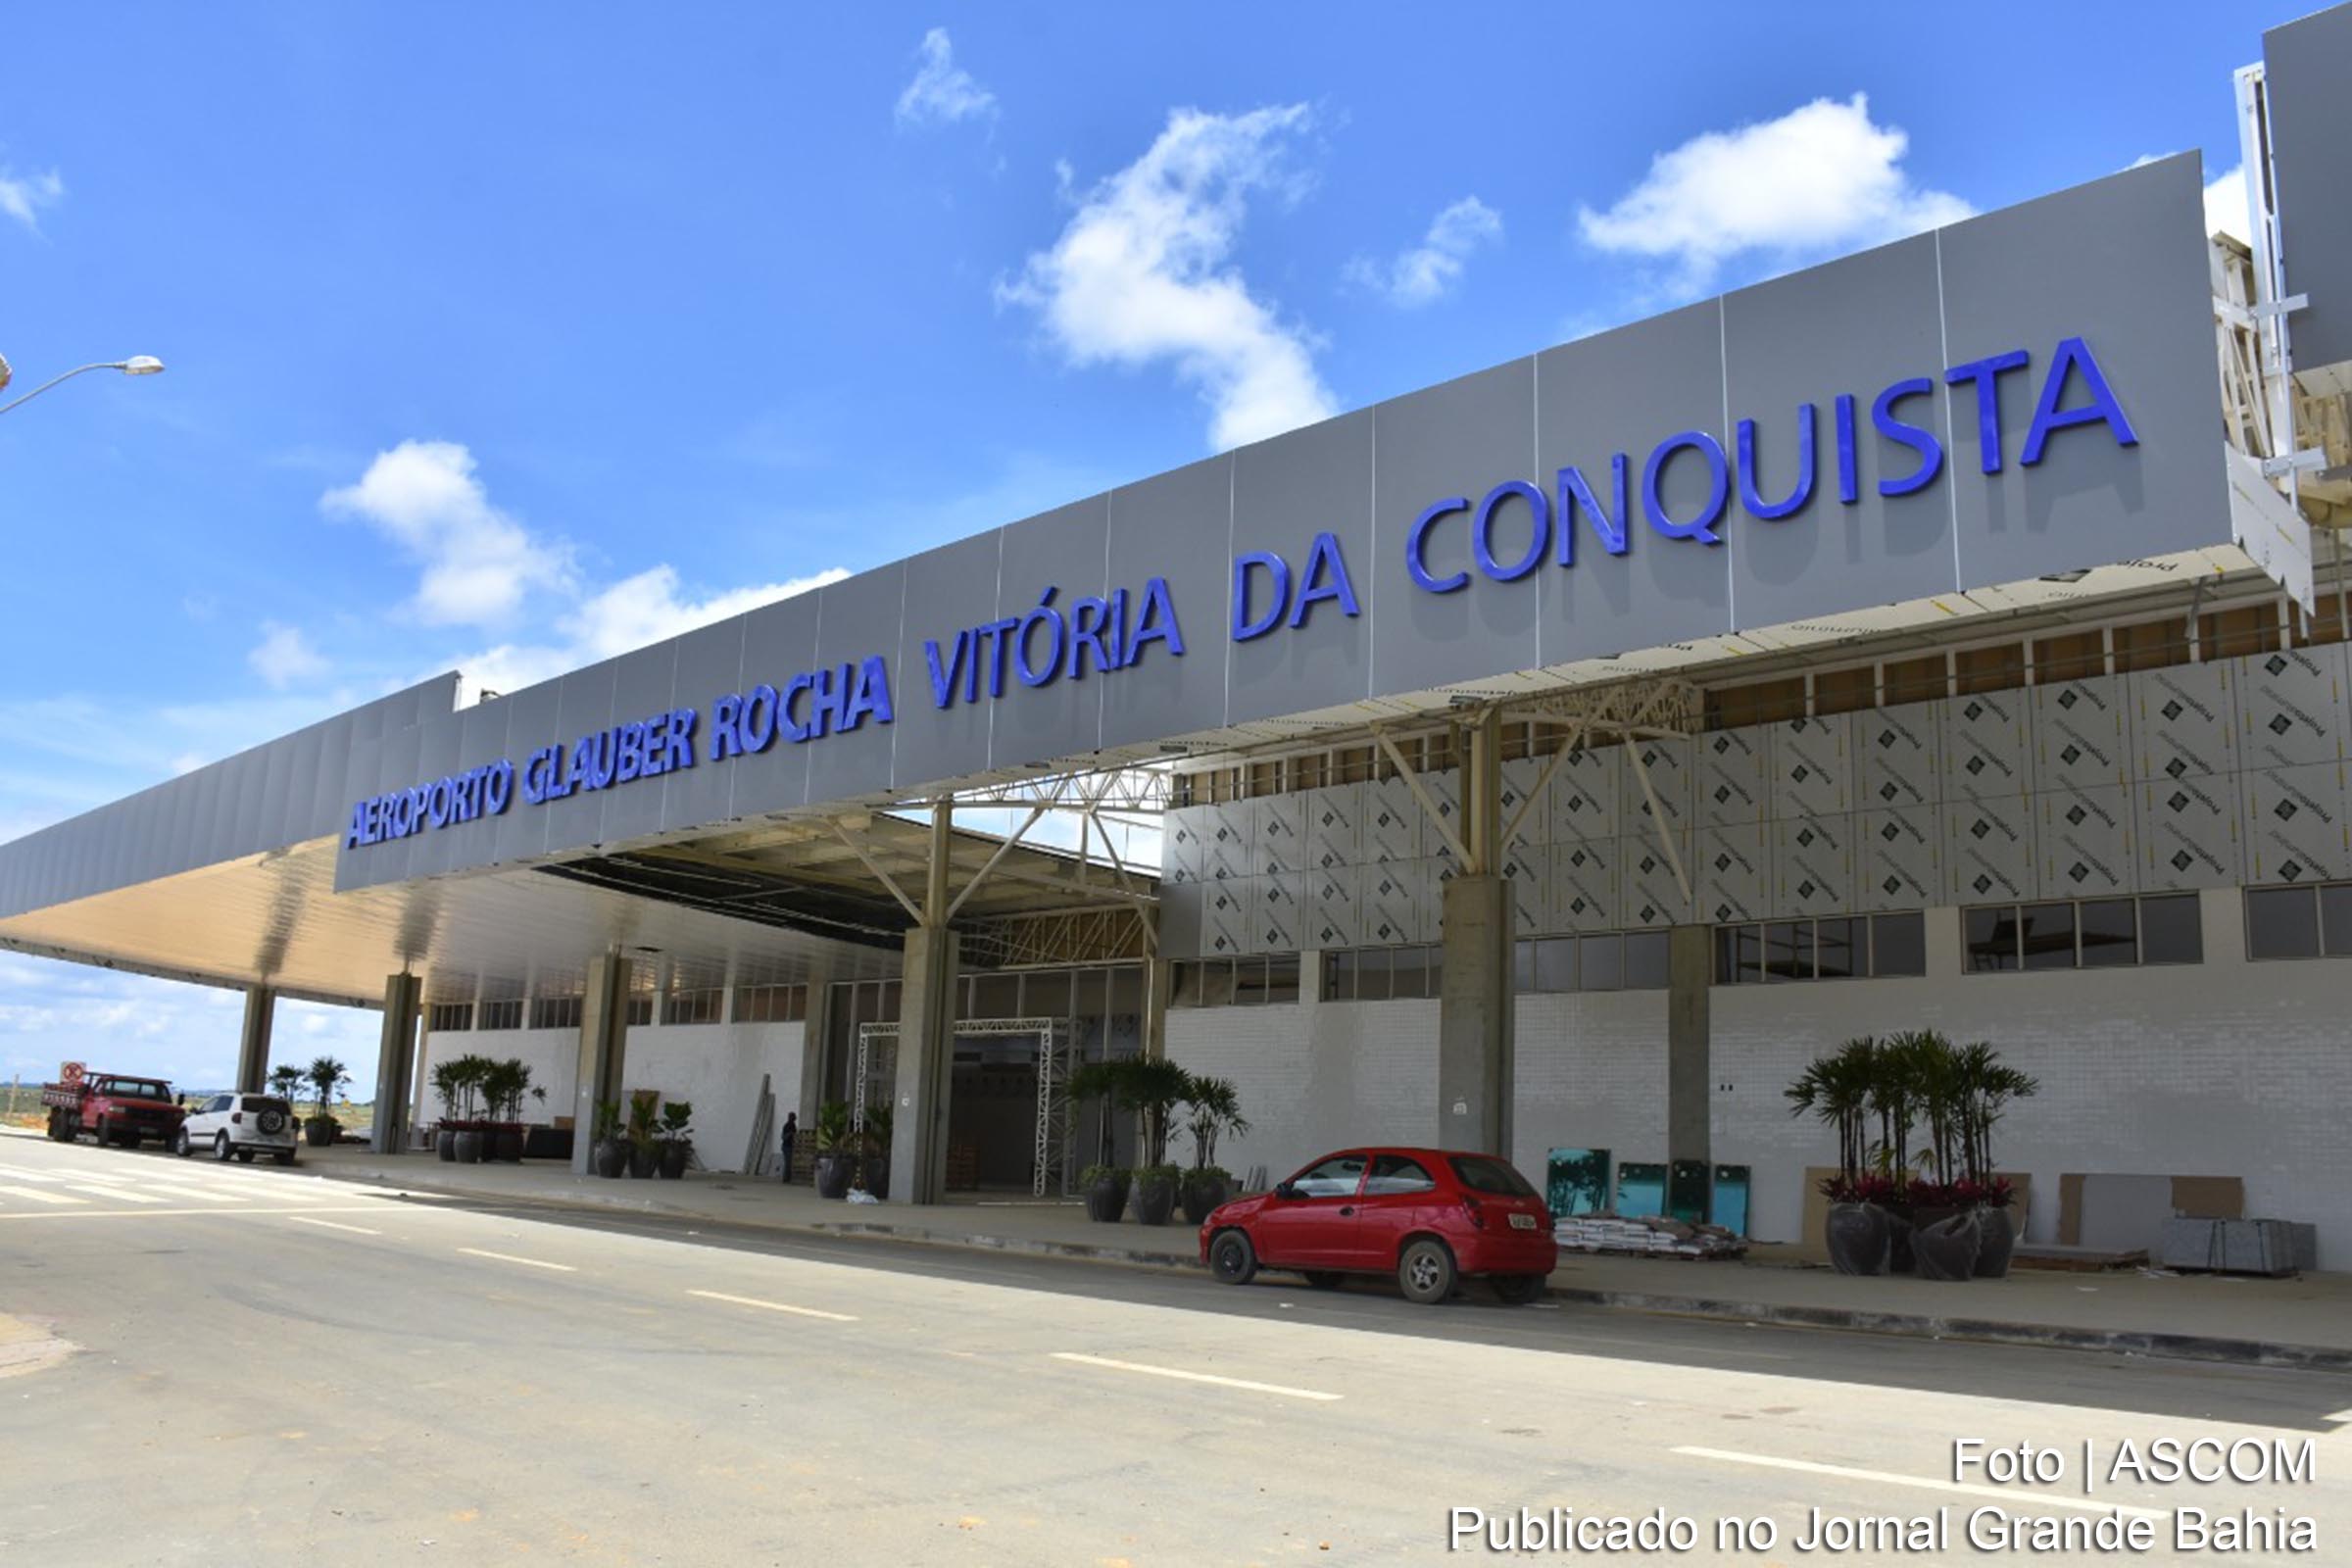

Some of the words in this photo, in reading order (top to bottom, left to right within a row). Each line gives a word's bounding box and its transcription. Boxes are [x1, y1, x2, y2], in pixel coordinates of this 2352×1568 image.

[348, 759, 515, 849] AEROPORTO
[521, 708, 698, 806] GLAUBER
[710, 654, 894, 761] ROCHA
[924, 585, 1185, 710] VITÓRIA
[1232, 530, 1360, 643] DA
[1406, 334, 2138, 595] CONQUISTA
